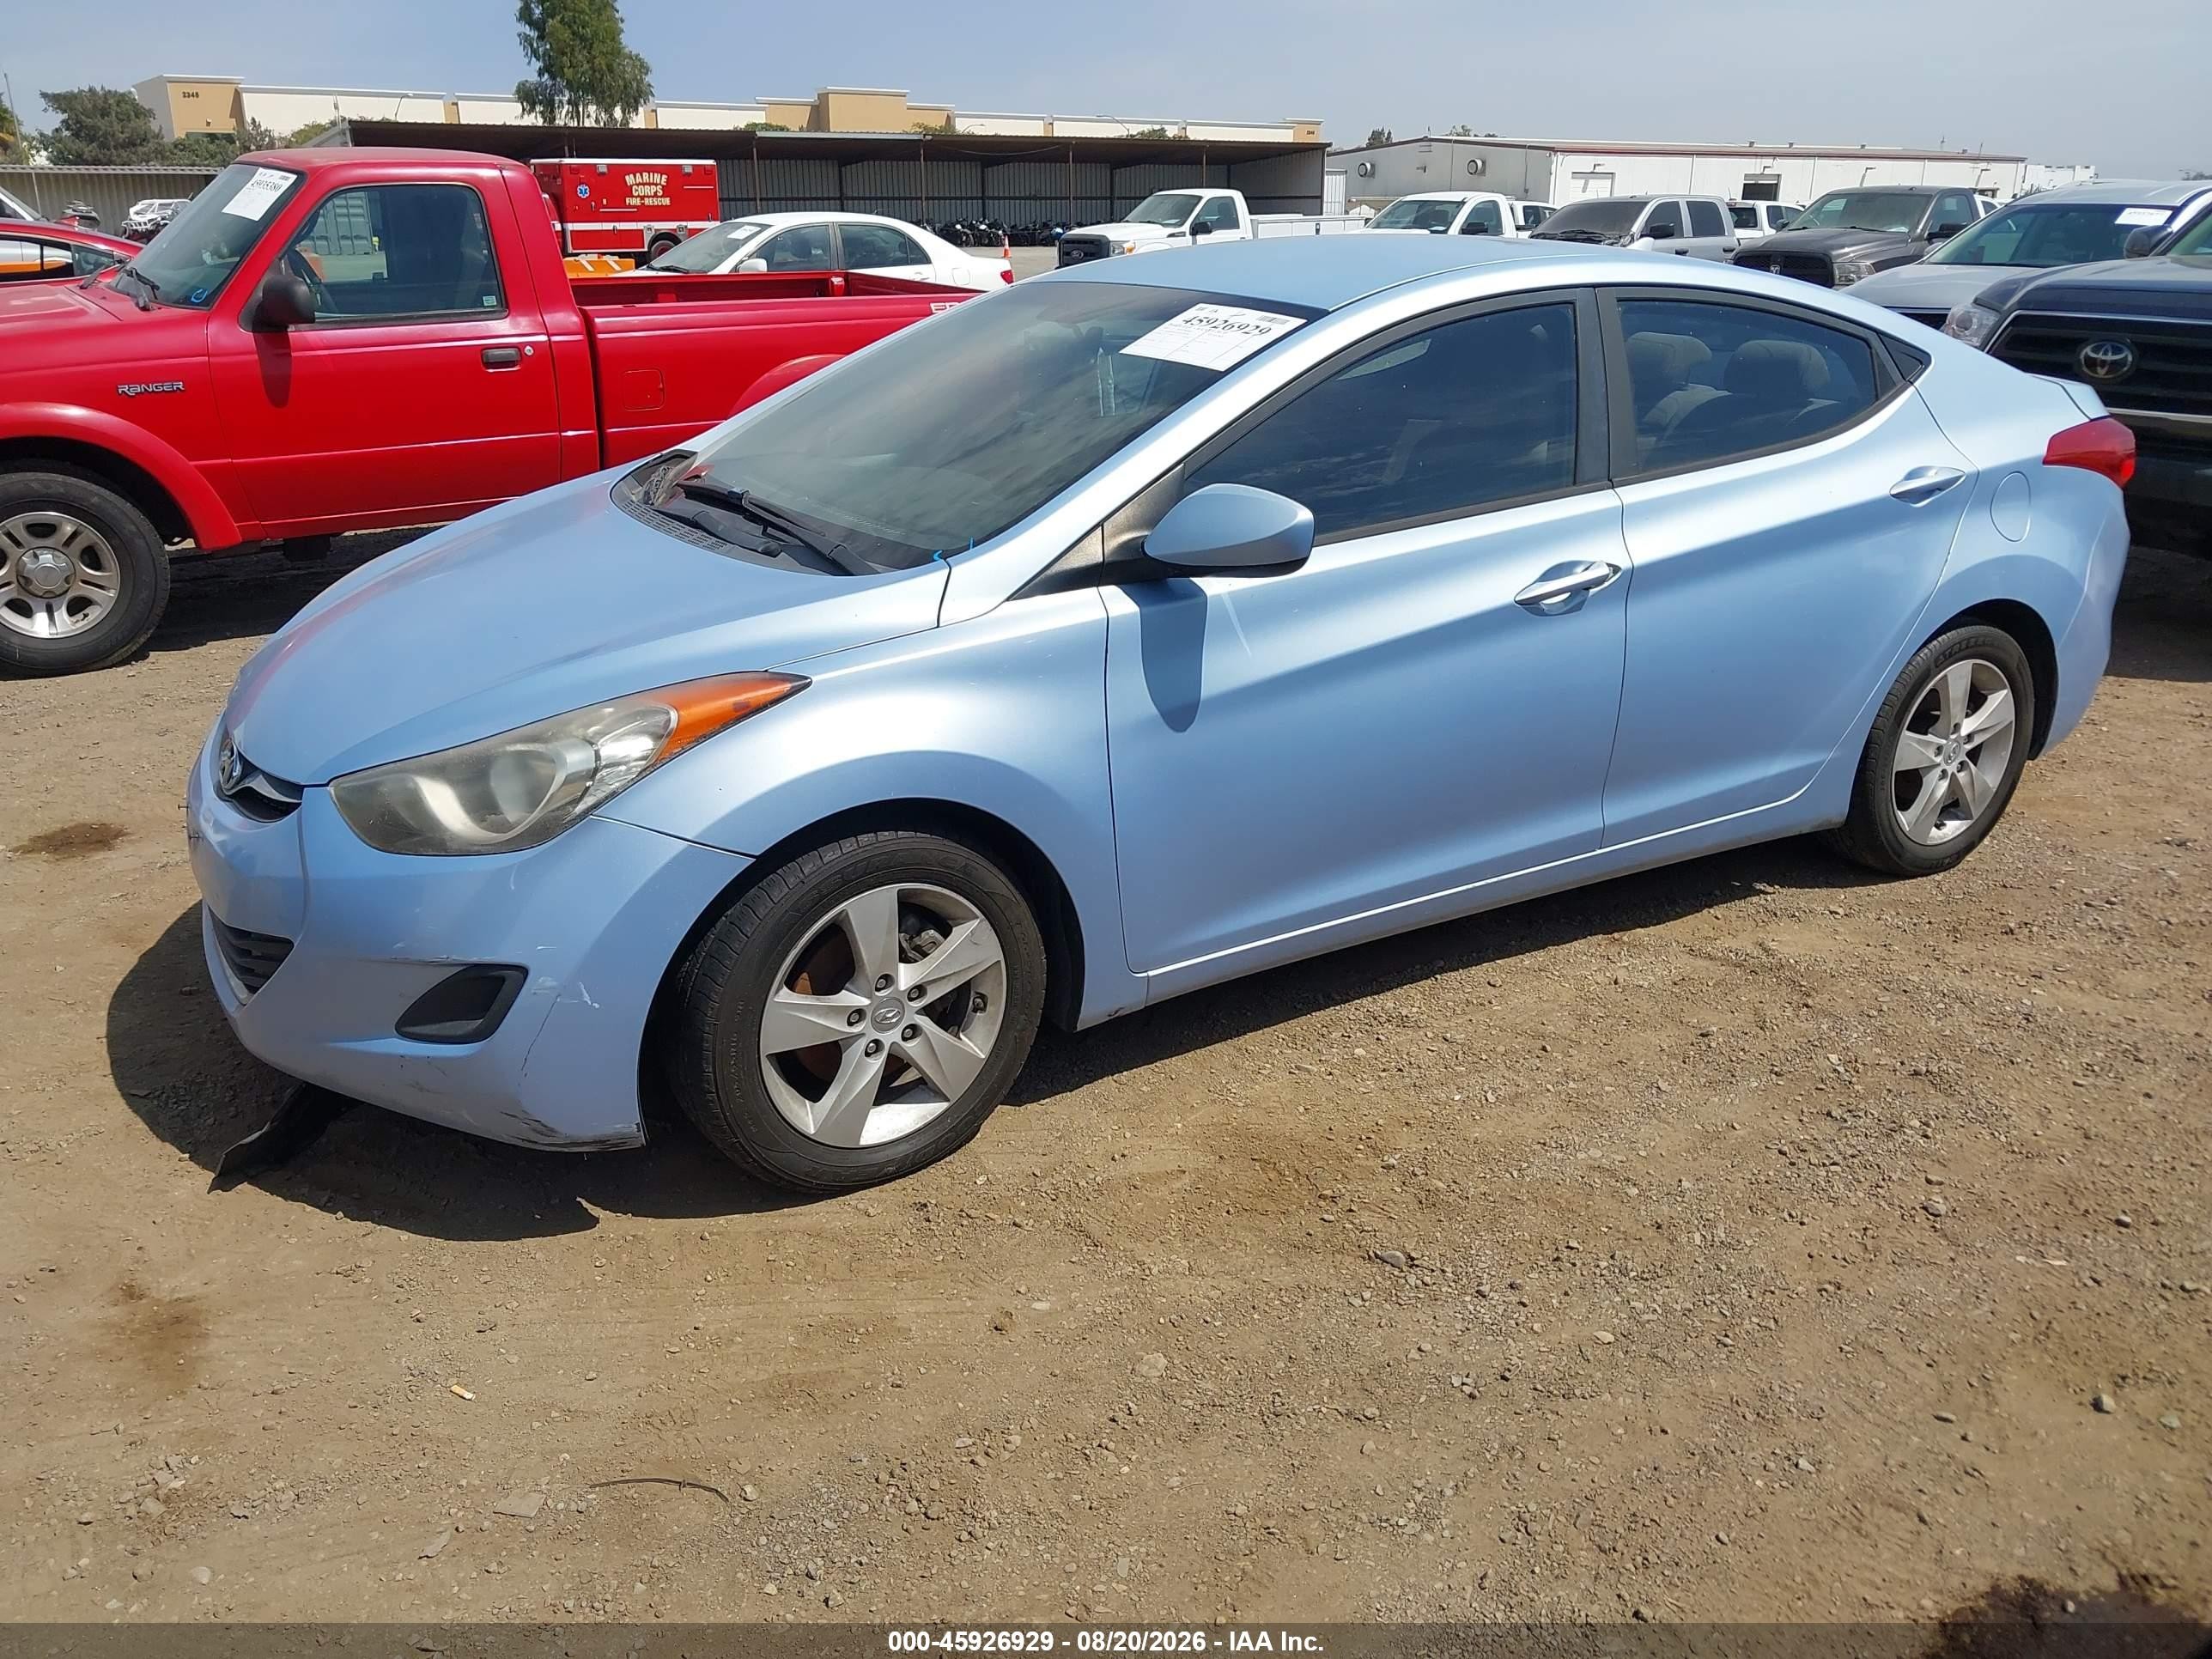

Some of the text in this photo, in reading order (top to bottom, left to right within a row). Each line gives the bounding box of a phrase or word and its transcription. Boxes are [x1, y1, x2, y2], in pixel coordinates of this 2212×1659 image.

[625, 172, 668, 185] MARINE
[632, 185, 663, 197] CORPS
[625, 197, 671, 206] FIRE-RESCUE
[1182, 316, 1272, 336] 45926929
